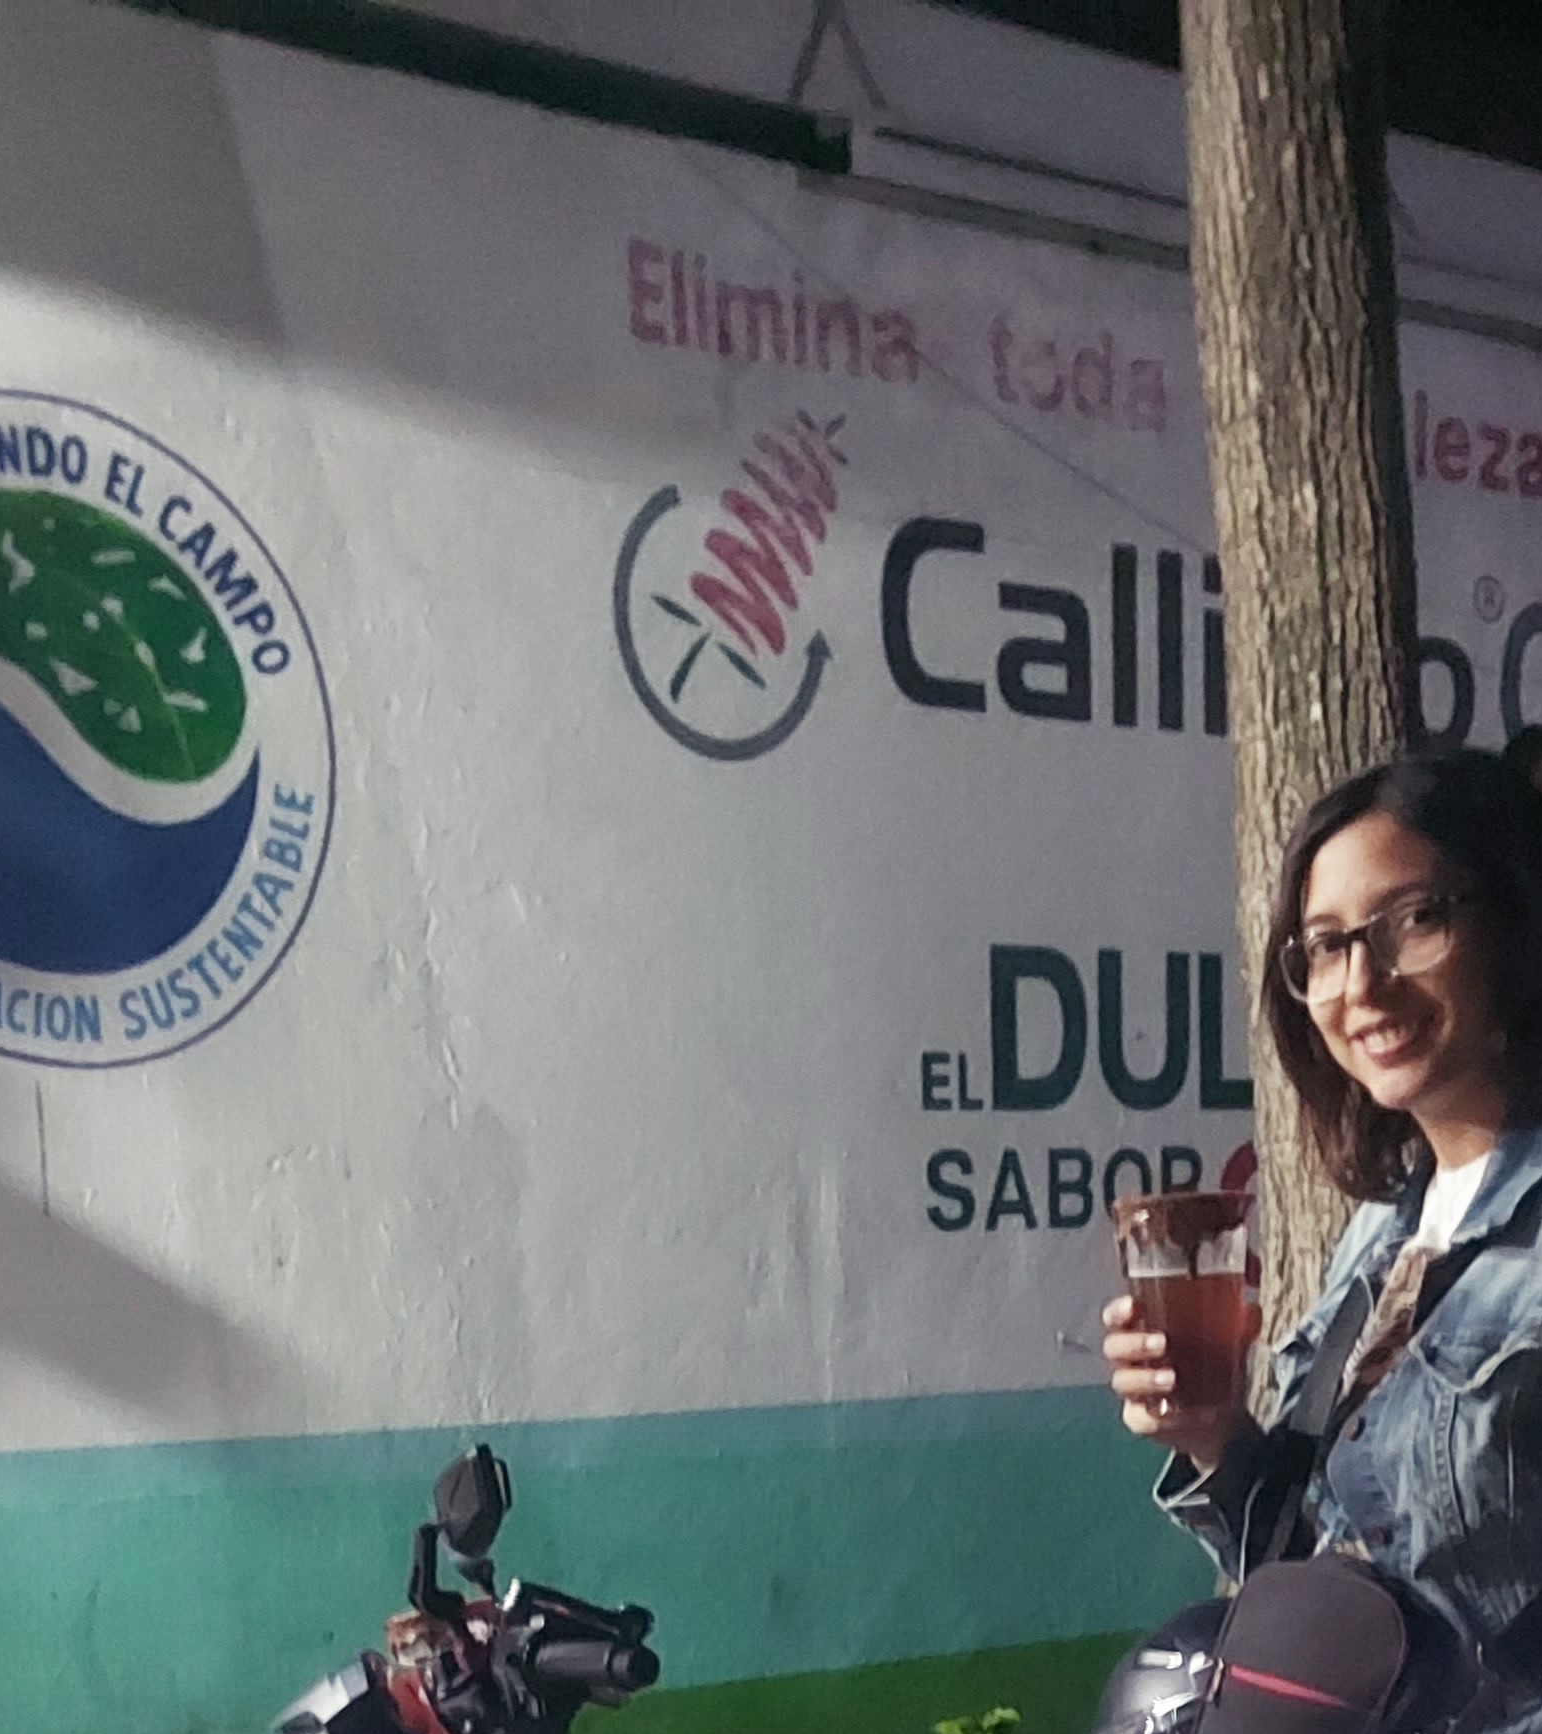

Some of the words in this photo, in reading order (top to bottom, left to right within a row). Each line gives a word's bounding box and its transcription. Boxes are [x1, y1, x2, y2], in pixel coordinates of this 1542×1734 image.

[626, 238, 920, 384] Elimina
[990, 312, 1169, 434] toda
[104, 455, 145, 516] EL
[159, 495, 292, 677] CAMPO
[880, 516, 1477, 750] Callio
[123, 783, 315, 1042] SUSTENTABLE
[921, 1051, 983, 1111] EL
[989, 943, 1255, 1112] DUL
